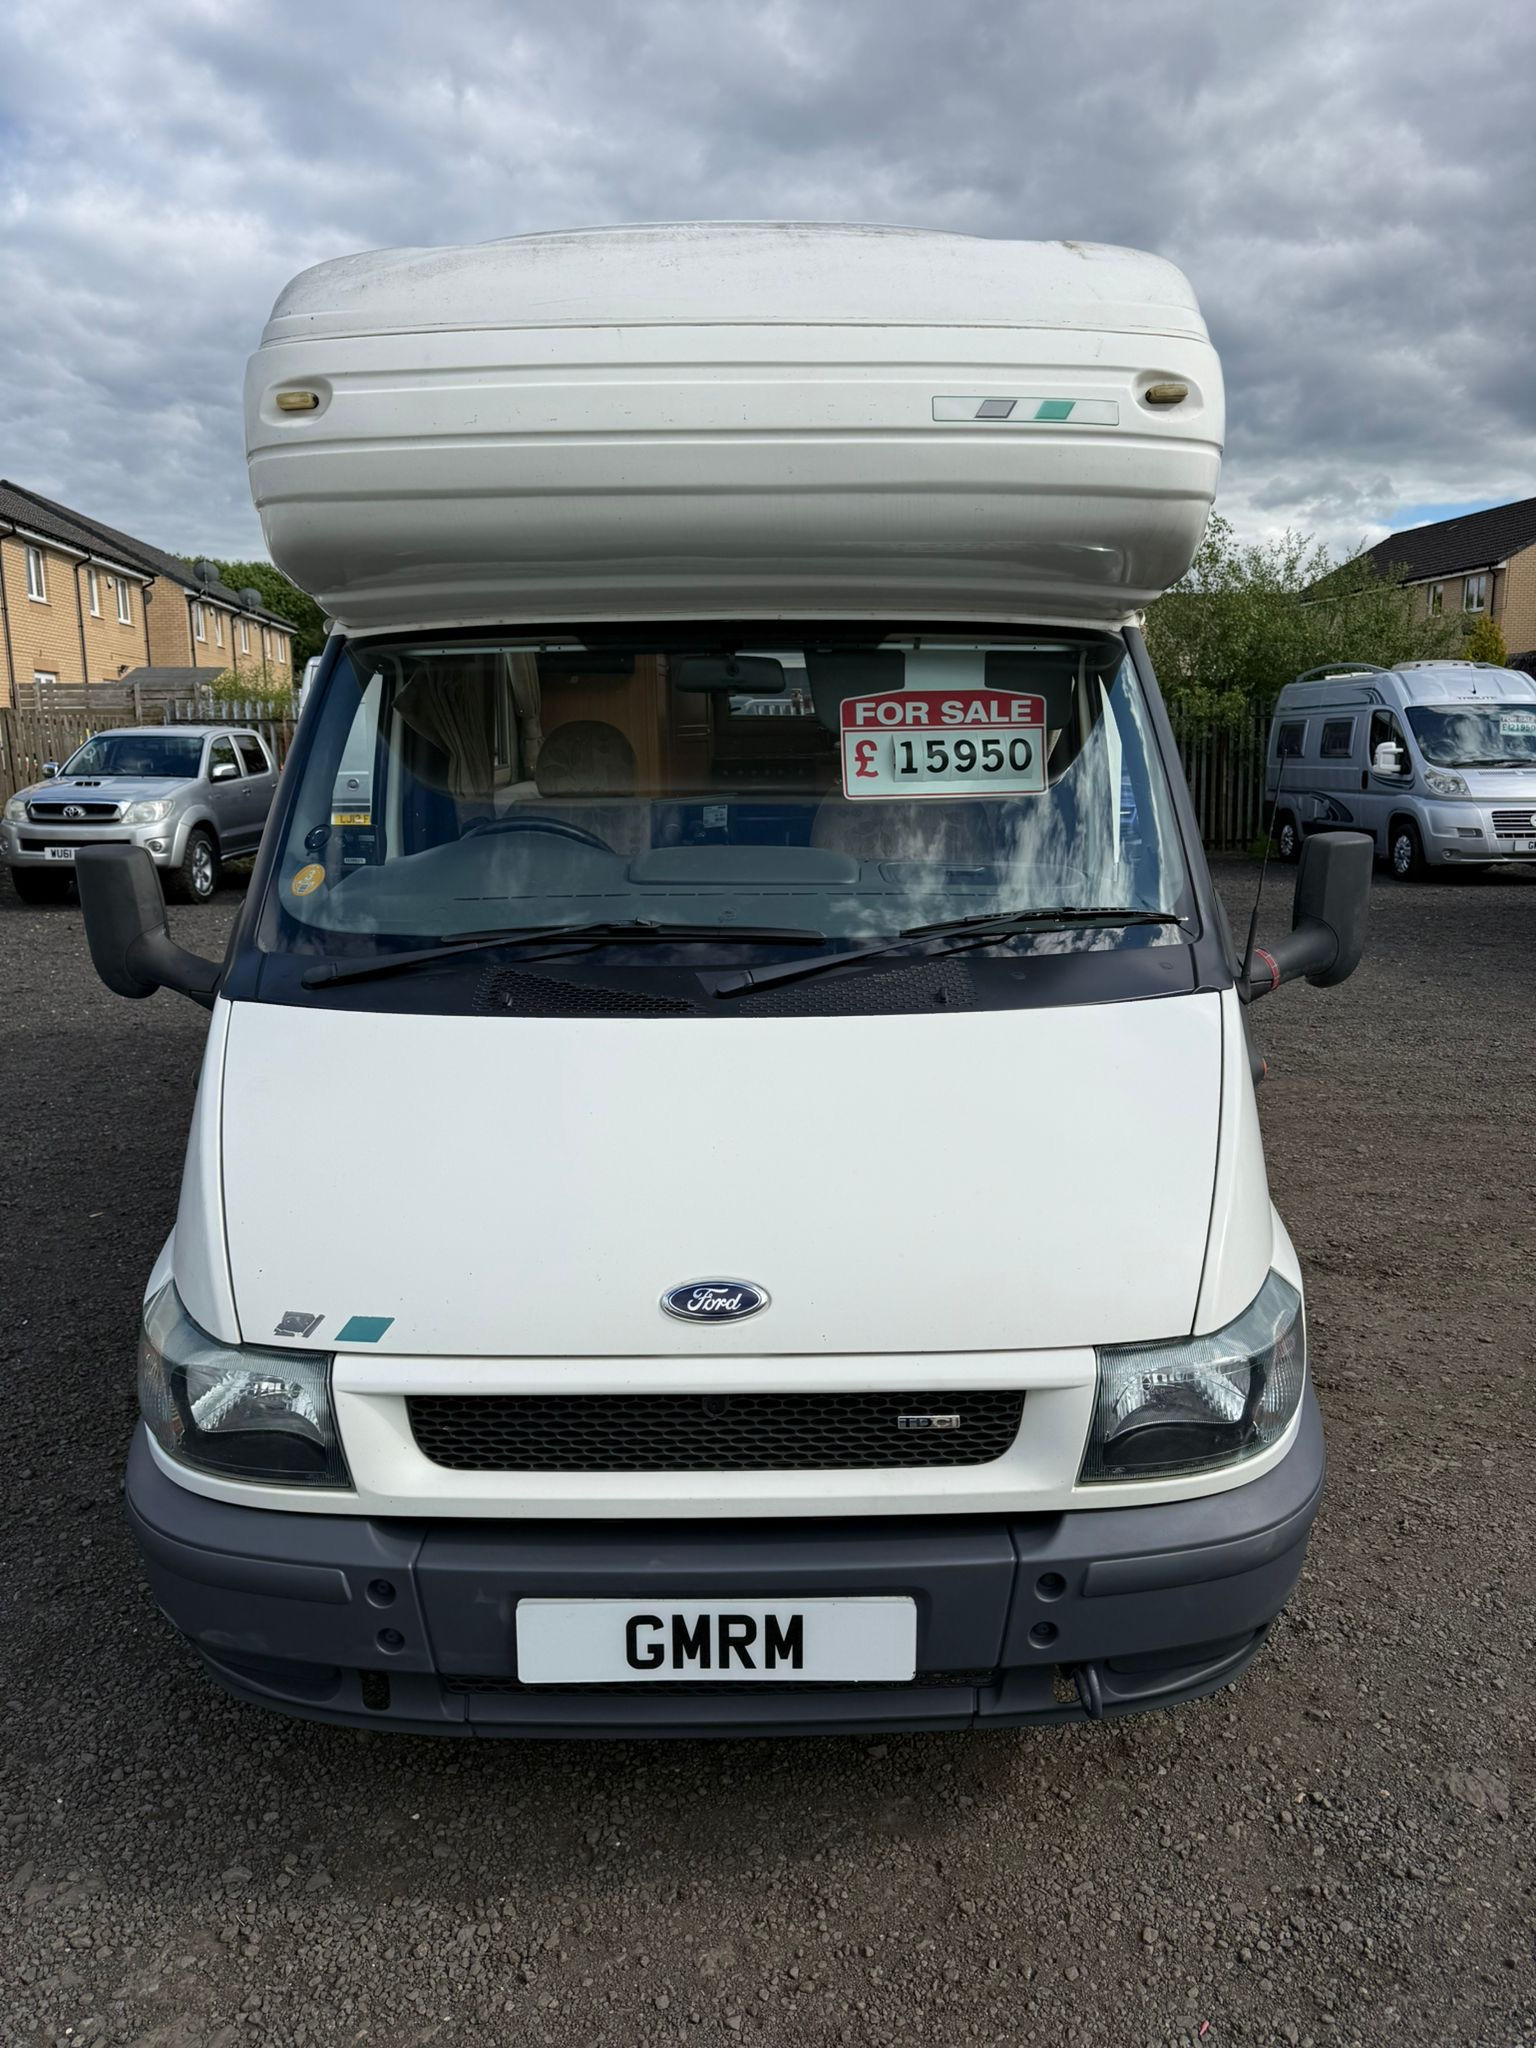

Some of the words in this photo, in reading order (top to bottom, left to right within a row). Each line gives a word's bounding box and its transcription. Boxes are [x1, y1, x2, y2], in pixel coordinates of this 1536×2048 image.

[855, 702, 929, 725] FOR
[941, 700, 1032, 724] SALE
[854, 739, 879, 778] £
[900, 738, 1032, 774] 15950
[50, 849, 72, 858] WU61
[687, 1287, 743, 1311] Ford
[626, 1614, 804, 1670] GMRM
